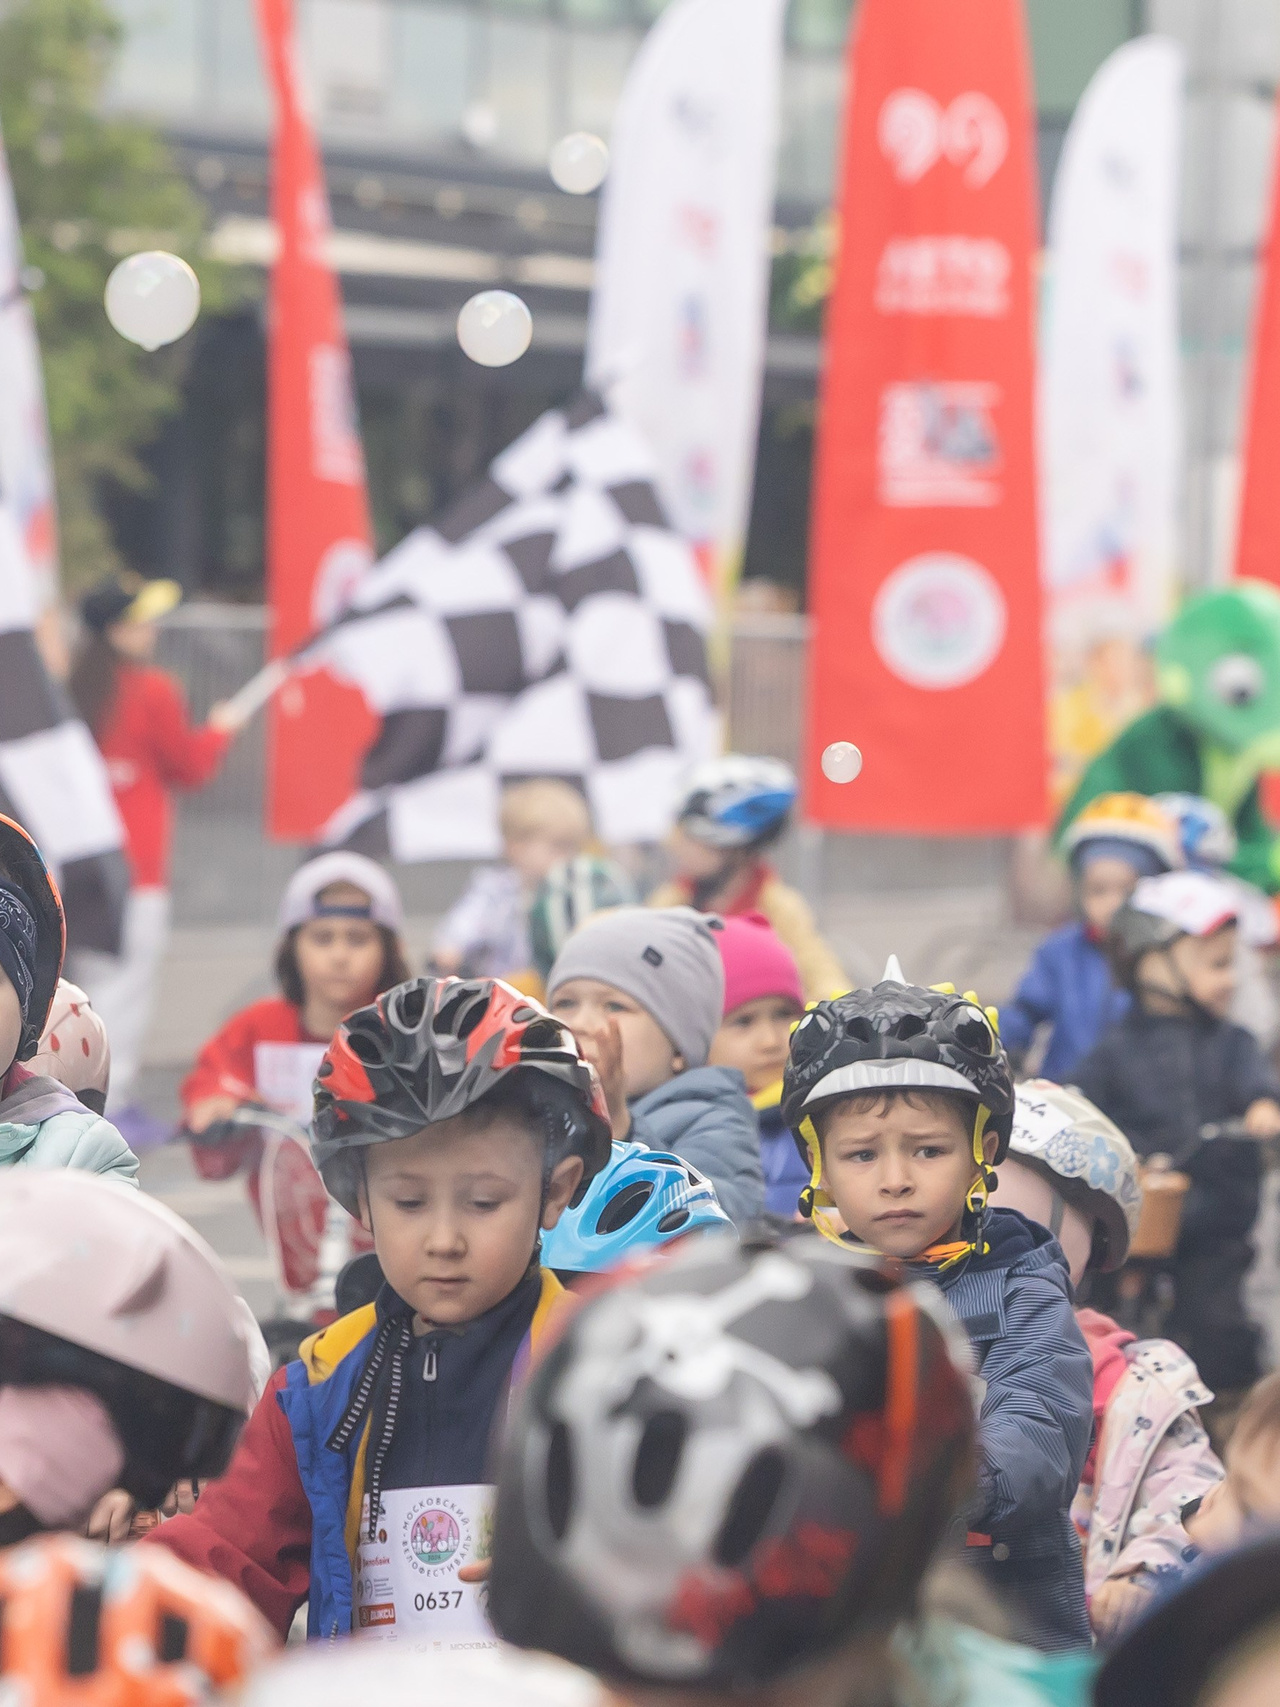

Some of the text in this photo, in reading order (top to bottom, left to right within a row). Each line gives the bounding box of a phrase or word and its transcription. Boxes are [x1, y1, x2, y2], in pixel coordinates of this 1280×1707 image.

[402, 1497, 470, 1531] МОСКОВСКИЙ
[402, 1535, 472, 1578] ВЕЛОФЕСТИВАЛЬ
[414, 1590, 463, 1612] 0637
